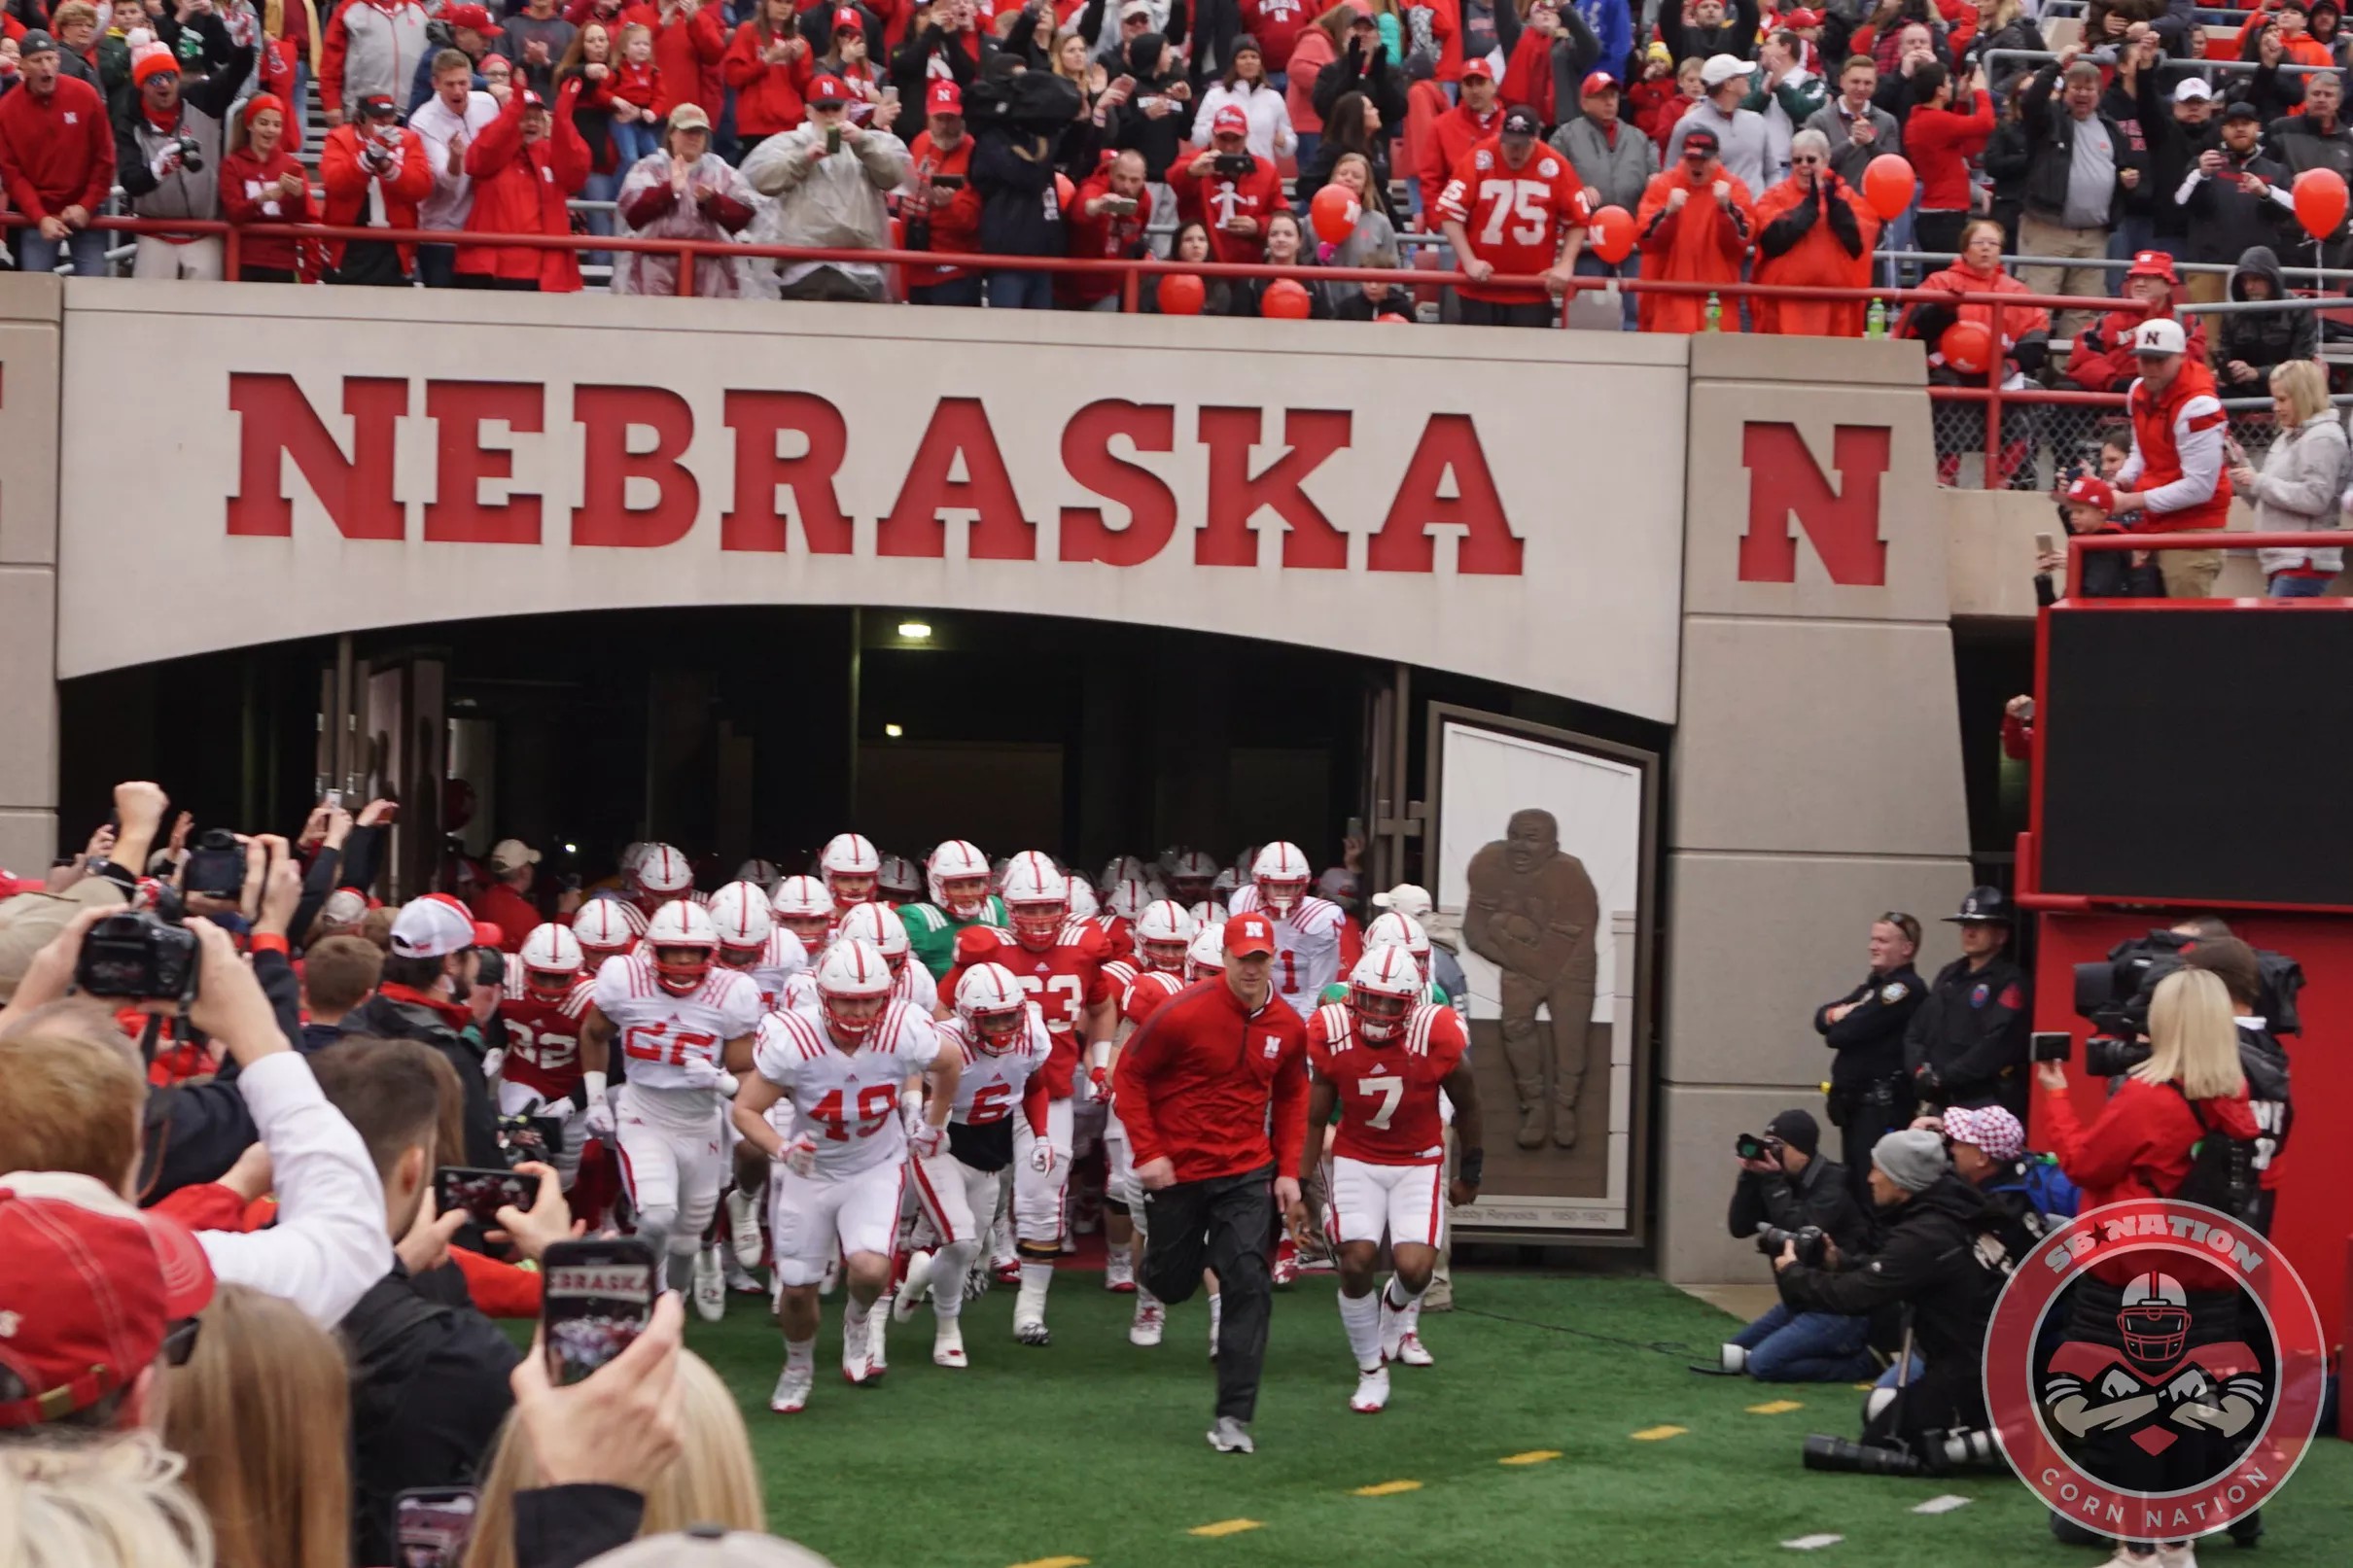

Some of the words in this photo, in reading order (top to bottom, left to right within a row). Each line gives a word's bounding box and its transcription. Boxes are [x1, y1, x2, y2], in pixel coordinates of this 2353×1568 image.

[822, 81, 834, 95] N
[937, 88, 951, 101] N
[1479, 179, 1551, 246] 75
[2144, 331, 2160, 346] N
[226, 371, 1525, 575] NEBRASKA
[1738, 420, 1892, 586] N
[1245, 921, 1264, 938] N
[503, 1018, 578, 1069] 32
[1265, 1034, 1282, 1053] N
[807, 1082, 897, 1142] 49
[966, 1082, 1012, 1127] 6
[1358, 1075, 1404, 1131] 7
